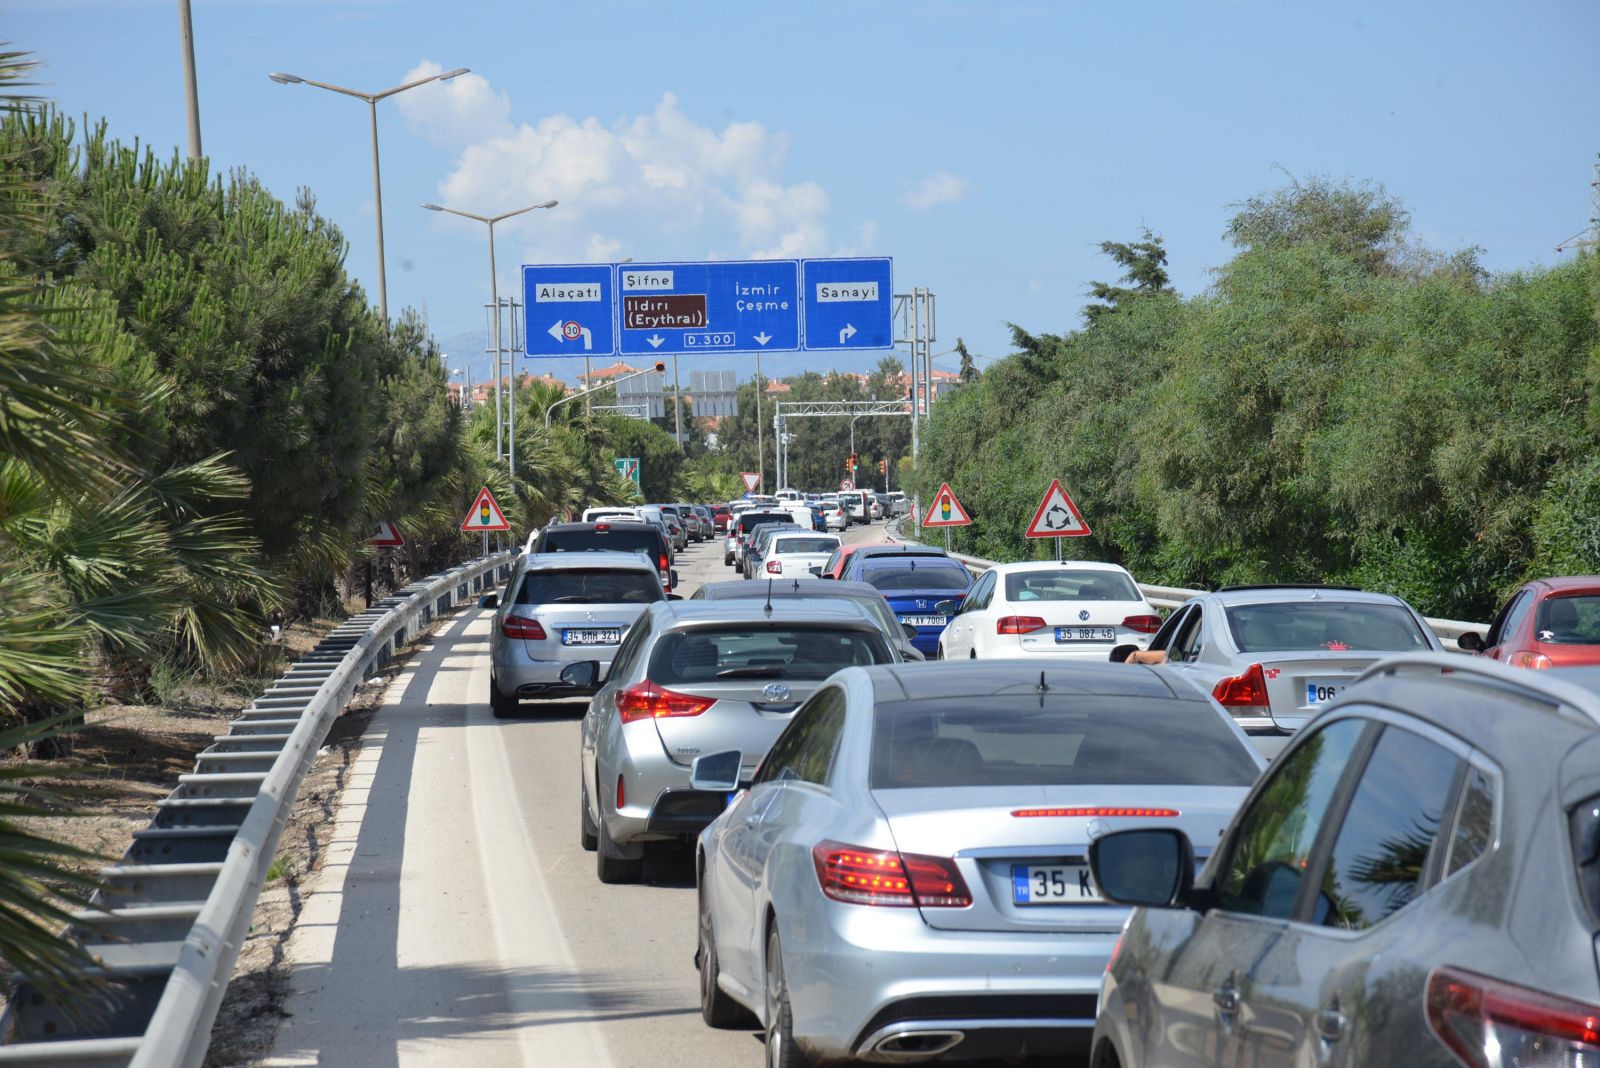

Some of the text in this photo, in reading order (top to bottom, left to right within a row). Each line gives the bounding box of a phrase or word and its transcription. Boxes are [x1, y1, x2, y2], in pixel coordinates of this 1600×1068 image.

[627, 275, 670, 287] Şifne
[540, 287, 598, 299] Alaçatı
[735, 281, 780, 295] İzmir
[821, 286, 875, 299] Sanayi
[736, 300, 789, 312] Çeşme
[628, 310, 703, 328] (Erythrai)
[566, 326, 578, 335] 30
[688, 335, 731, 345] D.300
[568, 628, 617, 641] 34 BMH 321
[1061, 629, 1073, 639] 35
[1101, 629, 1113, 639] 46
[1017, 887, 1029, 896] TR
[1034, 870, 1066, 897] 35
